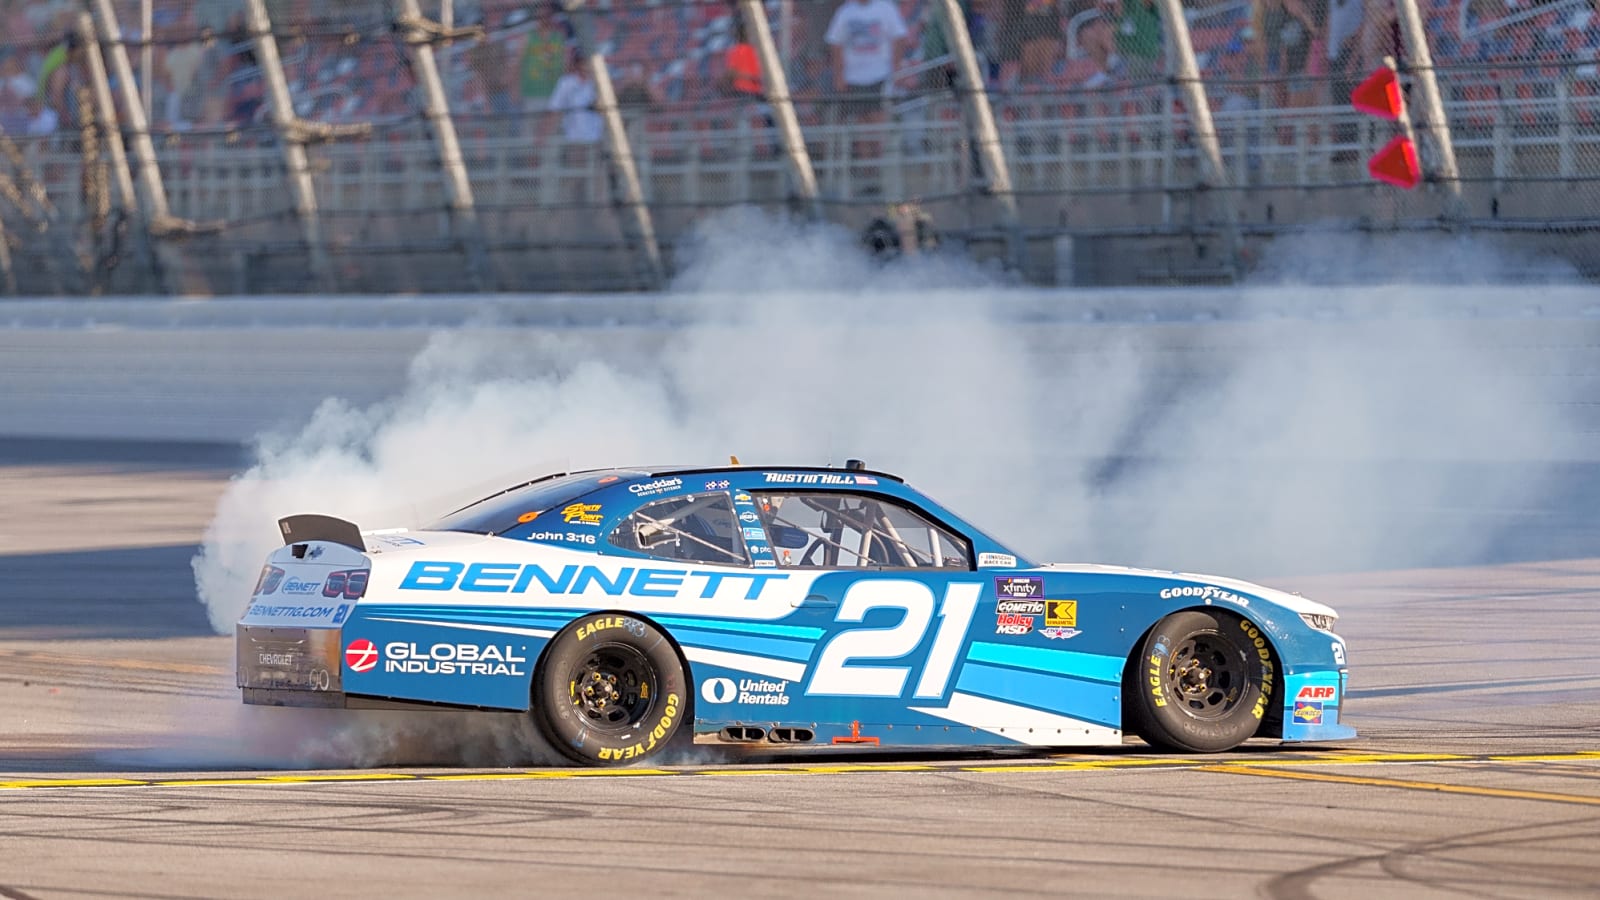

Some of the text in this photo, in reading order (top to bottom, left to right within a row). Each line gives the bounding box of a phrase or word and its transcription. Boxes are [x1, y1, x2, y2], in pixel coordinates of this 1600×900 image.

[817, 474, 854, 484] HILL
[527, 531, 596, 545] John 3:16
[283, 582, 321, 592] BENNETT
[397, 560, 790, 600] BENNETT
[1003, 583, 1037, 596] xfinity
[1160, 586, 1250, 608] GOODYEAR
[249, 604, 334, 618] BENNETTIG.COM
[998, 601, 1044, 613] COMETIC
[997, 613, 1034, 627] Holley
[576, 617, 625, 641] EAGLE
[995, 625, 1029, 634] MSD
[804, 578, 985, 699] 21
[259, 653, 292, 665] CHEVROLET
[385, 642, 526, 663] GLOBAL
[385, 660, 525, 676] INDUSTRIAL
[739, 679, 786, 693] United
[1150, 655, 1168, 707] EAGLE
[738, 692, 790, 706] Rentals
[1297, 687, 1335, 698] ARP
[598, 693, 679, 760] GOODYEAR
